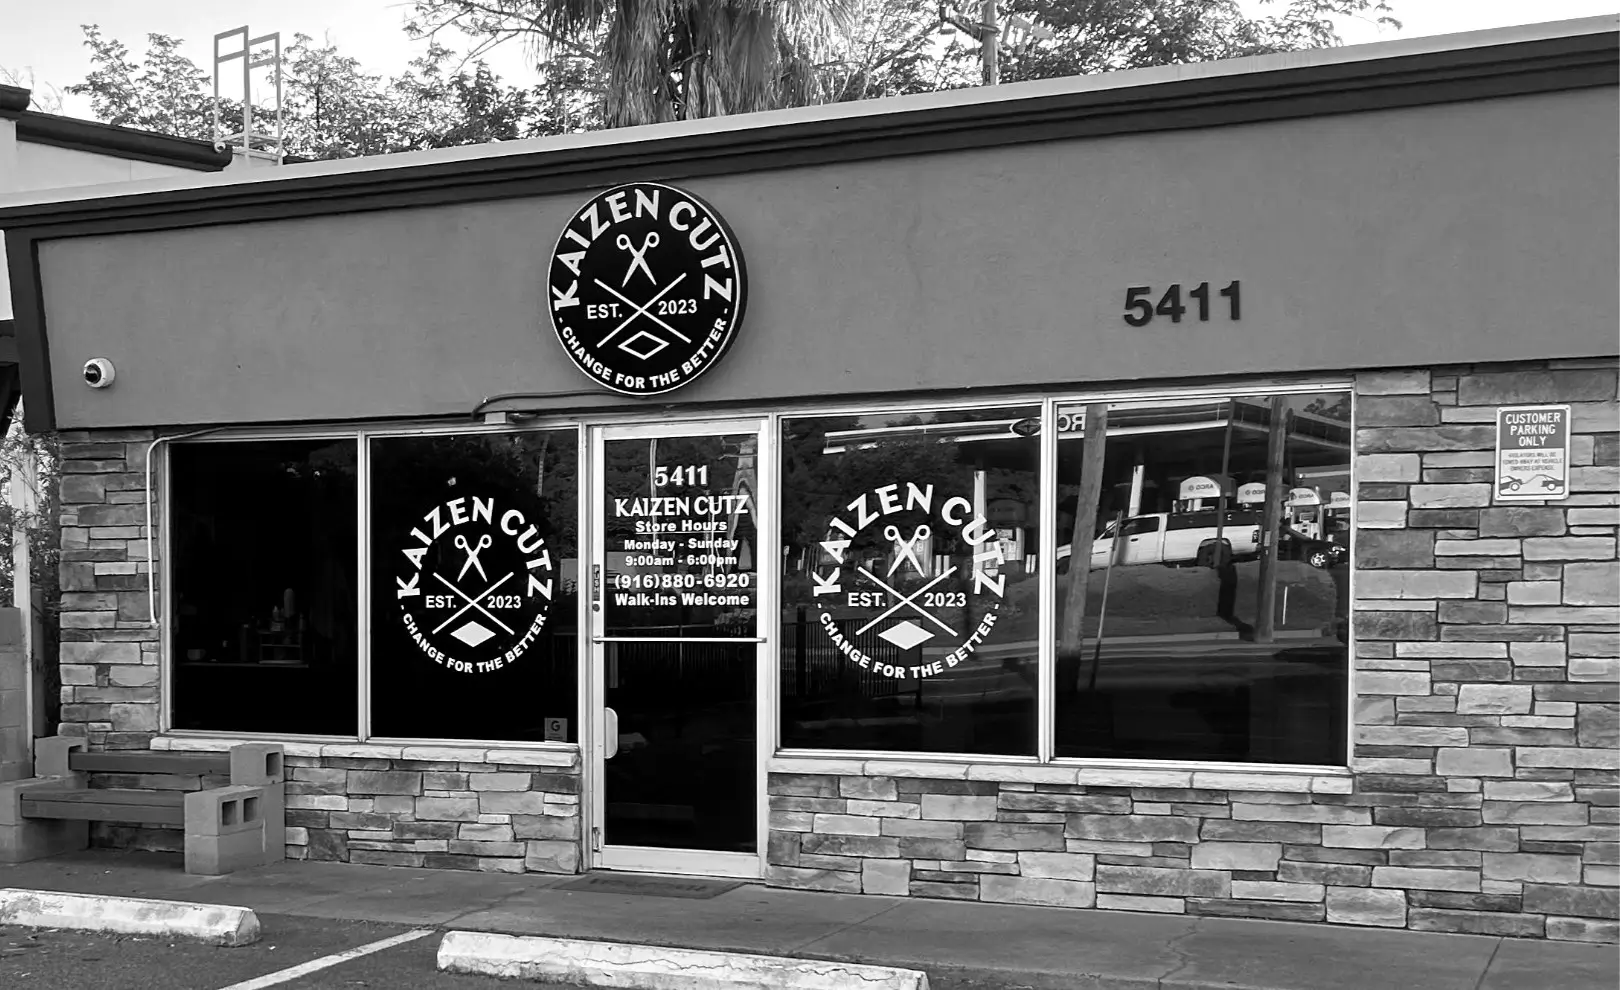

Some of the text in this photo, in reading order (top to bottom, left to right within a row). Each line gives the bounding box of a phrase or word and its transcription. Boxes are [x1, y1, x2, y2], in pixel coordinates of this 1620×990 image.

[551, 188, 732, 311] KAIZEN CUTZ
[586, 299, 698, 319] EST. 2023
[1123, 280, 1240, 327] 5411
[562, 326, 613, 380] CHANGE
[615, 374, 645, 389] FOR
[649, 369, 680, 388] THE
[681, 317, 728, 375] BETTER
[1505, 412, 1561, 425] CUSTOMER
[1510, 424, 1556, 436] PARKING
[1518, 436, 1547, 447] ONLY
[654, 465, 708, 486] 5411
[614, 495, 750, 517] KAIZEN CUTZ
[635, 519, 728, 533] Store Hours
[396, 495, 553, 601] KAIZEN CUTZ
[624, 539, 676, 551] Monday
[688, 538, 739, 550] Sunday
[812, 482, 1006, 599] KAIZEN CUTZ
[625, 555, 674, 566] 9:00am
[686, 554, 738, 567] 6:00pm
[614, 573, 750, 589] (916)880-6920
[425, 595, 522, 609] EST. 2023
[615, 593, 750, 606] Walk-Ins Welcome
[847, 592, 967, 607] EST. 2023
[402, 613, 446, 664] CHANGE
[446, 657, 474, 673] FOR
[476, 656, 503, 673] THE
[504, 613, 547, 663] BETTER
[819, 612, 871, 669] CHANGE
[873, 661, 906, 679] FOR
[909, 660, 944, 679] THE
[945, 612, 998, 668] BETTER
[551, 720, 561, 732] G
